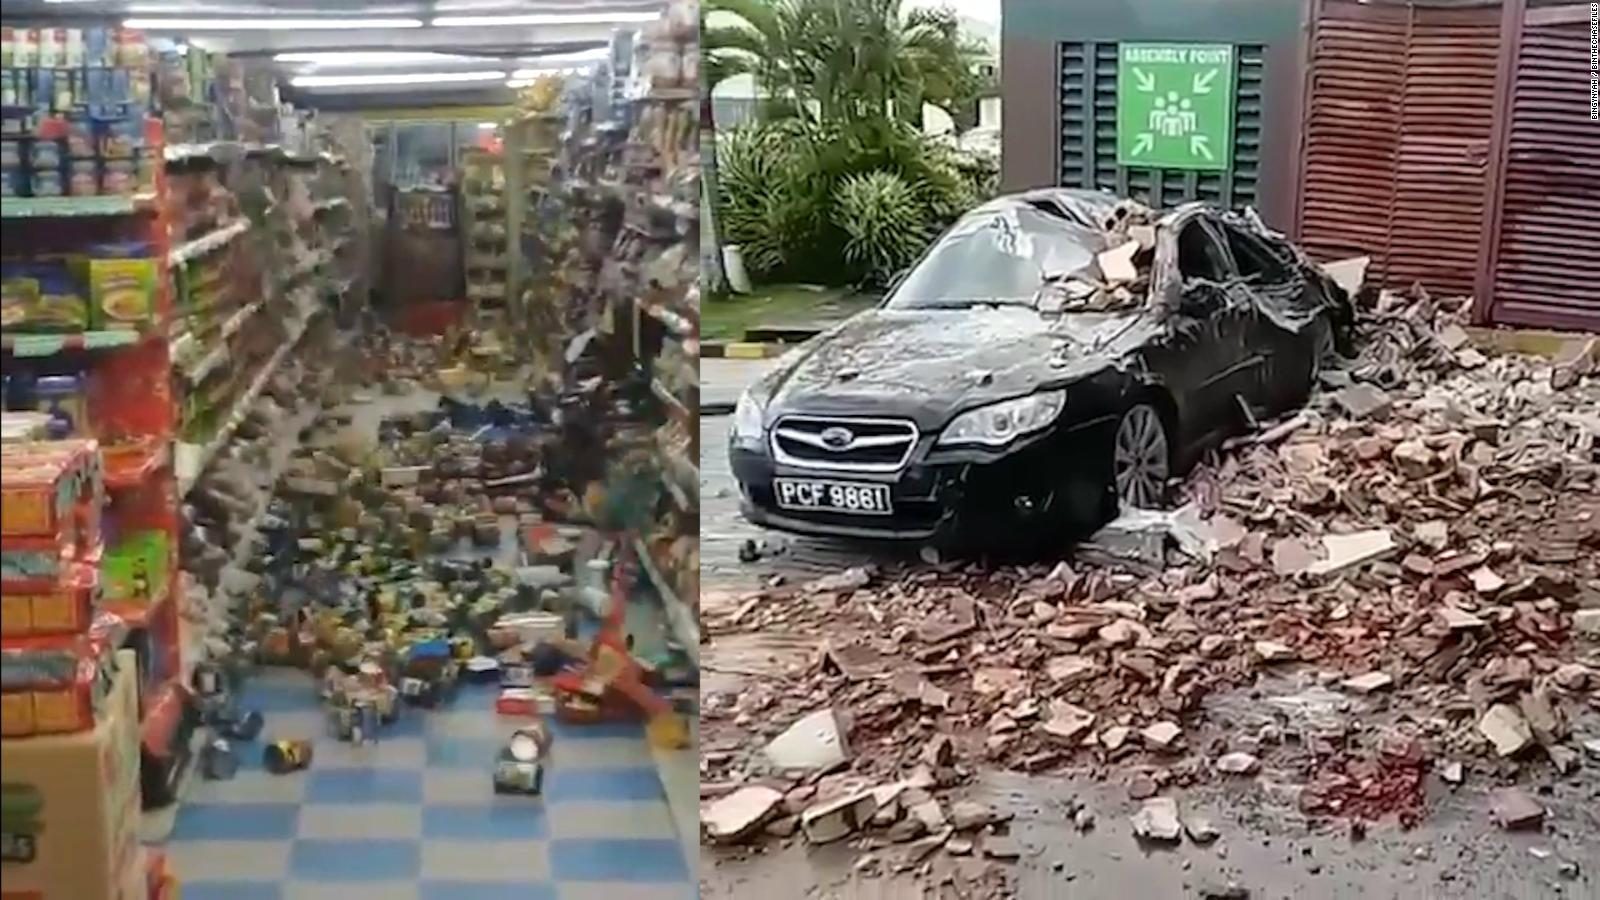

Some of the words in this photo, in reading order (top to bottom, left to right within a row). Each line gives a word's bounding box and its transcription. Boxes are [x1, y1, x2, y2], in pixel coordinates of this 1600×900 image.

[1125, 48, 1187, 63] ASSEMBLY
[1189, 49, 1227, 64] POINT
[782, 482, 824, 506] PCF
[830, 485, 883, 510] 9861
